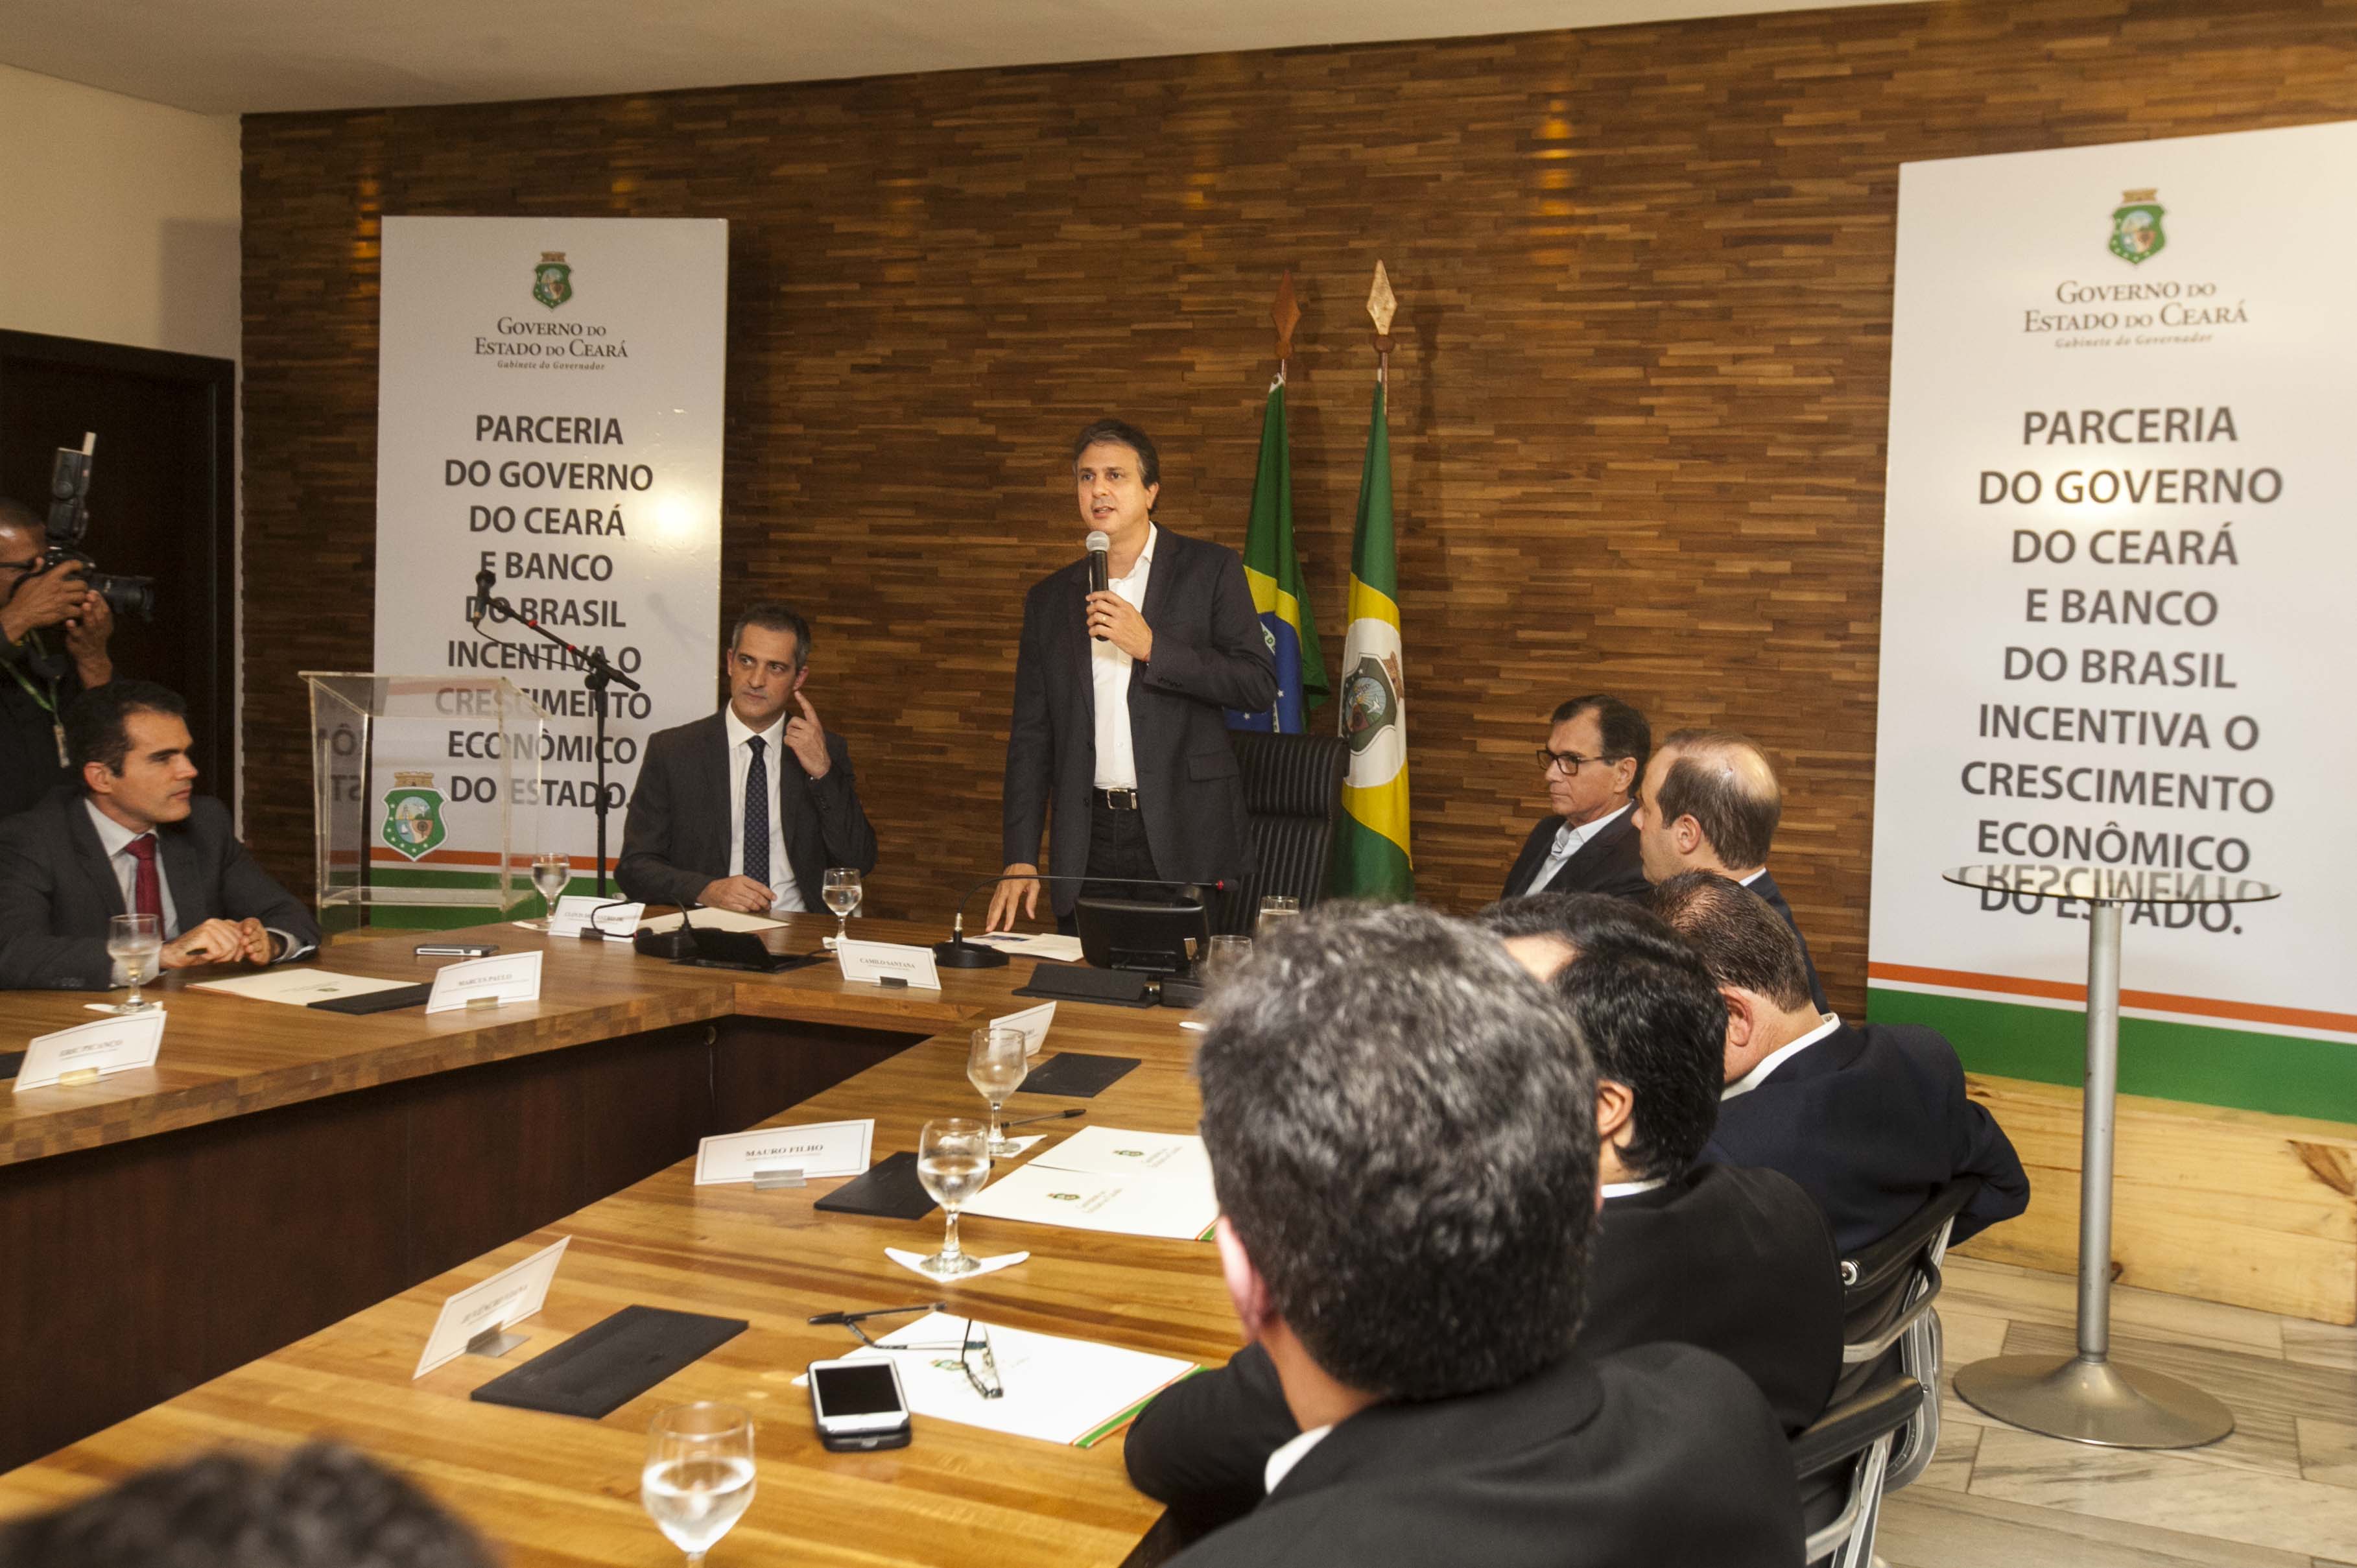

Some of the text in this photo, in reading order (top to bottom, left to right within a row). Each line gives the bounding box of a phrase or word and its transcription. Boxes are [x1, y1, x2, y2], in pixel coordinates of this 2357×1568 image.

[2056, 280, 2216, 304] GOVERNO DO
[497, 316, 606, 336] GOVERNO DO
[2023, 299, 2248, 333] ESTADO DO CEARÁ
[475, 337, 628, 358] ESTADO DO CEARÁ
[497, 360, 605, 370] Gabinete do Governador
[476, 414, 624, 445] PARCERIA
[2023, 407, 2238, 445] PARCERIA
[445, 459, 653, 491] DO GOVERNO
[1979, 468, 2283, 505] DO GOVERNO
[469, 503, 626, 536] DO CEARÁ
[2012, 521, 2239, 566] DO CEARÁ
[480, 551, 613, 581] E BANCO
[520, 597, 626, 628] BRASIL
[2026, 588, 2218, 626] E BANCO
[618, 647, 642, 674] O
[2004, 646, 2238, 689] DO BRASIL
[1979, 703, 2260, 751] INCENTIVA O
[448, 728, 637, 764] ECONÔMICO
[451, 776, 497, 803] DO
[1961, 761, 2275, 814] CRESCIMENTO
[1978, 819, 2251, 873] ECONÔMICO
[745, 1144, 823, 1158] MAURO FILHO
